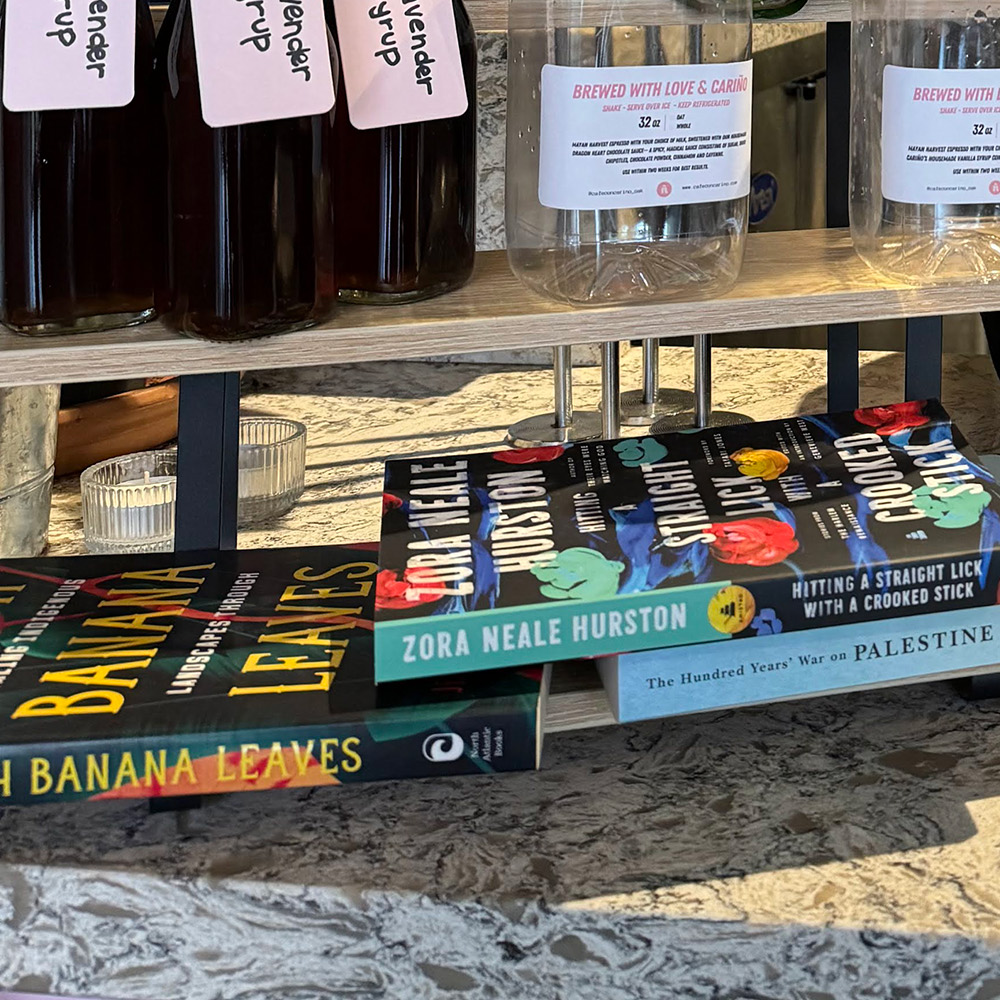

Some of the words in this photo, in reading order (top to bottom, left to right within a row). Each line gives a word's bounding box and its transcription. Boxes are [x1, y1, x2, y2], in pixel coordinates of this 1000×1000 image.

[572, 84, 627, 99] BREWED
[630, 82, 662, 97] WITH
[665, 81, 695, 96] LOVE
[697, 79, 707, 94] &
[711, 75, 748, 94] CARIÑO
[602, 104, 622, 112] SHAKE
[627, 103, 645, 111] SERVE
[645, 102, 660, 110] OVER
[678, 100, 692, 109] KEEP
[692, 99, 731, 108] REFRIGERATED
[913, 87, 962, 102] BREWED
[964, 87, 994, 101] WITH
[639, 116, 652, 128] 32
[972, 123, 984, 135] 32
[408, 459, 471, 528] NEALE
[711, 475, 778, 517] LICK
[778, 474, 812, 502] WITH
[834, 433, 928, 523] CROOKED
[903, 439, 984, 498] STICK
[487, 469, 558, 573] HURSTON
[573, 492, 606, 533] HITTING
[640, 459, 717, 548] STRAIGHT
[406, 533, 474, 600] ZORA
[792, 575, 855, 600] HITTING
[860, 573, 871, 591] A
[875, 563, 945, 588] STRAIGHT
[950, 559, 982, 579] LICK
[12, 578, 87, 643] INDIGENOUS
[227, 560, 379, 697] LEAVES
[804, 597, 846, 618] WITH
[849, 595, 859, 613] A
[863, 587, 930, 611] CROOKED
[934, 581, 974, 602] STICK
[11, 563, 216, 719] BANANA
[166, 619, 232, 695] LANDSCAPES
[214, 572, 260, 619] THROUGH
[402, 630, 470, 663] ZORA
[483, 619, 563, 654] NEALE
[572, 602, 687, 642] HURSTON
[646, 675, 675, 690] The
[680, 665, 745, 685] Hundred
[798, 652, 826, 667] War
[831, 653, 847, 663] on
[854, 624, 994, 662] PALESTINE
[30, 747, 196, 796] BANANA
[217, 736, 363, 781] LEAVES
[470, 731, 480, 758] North
[493, 729, 503, 757] Books
